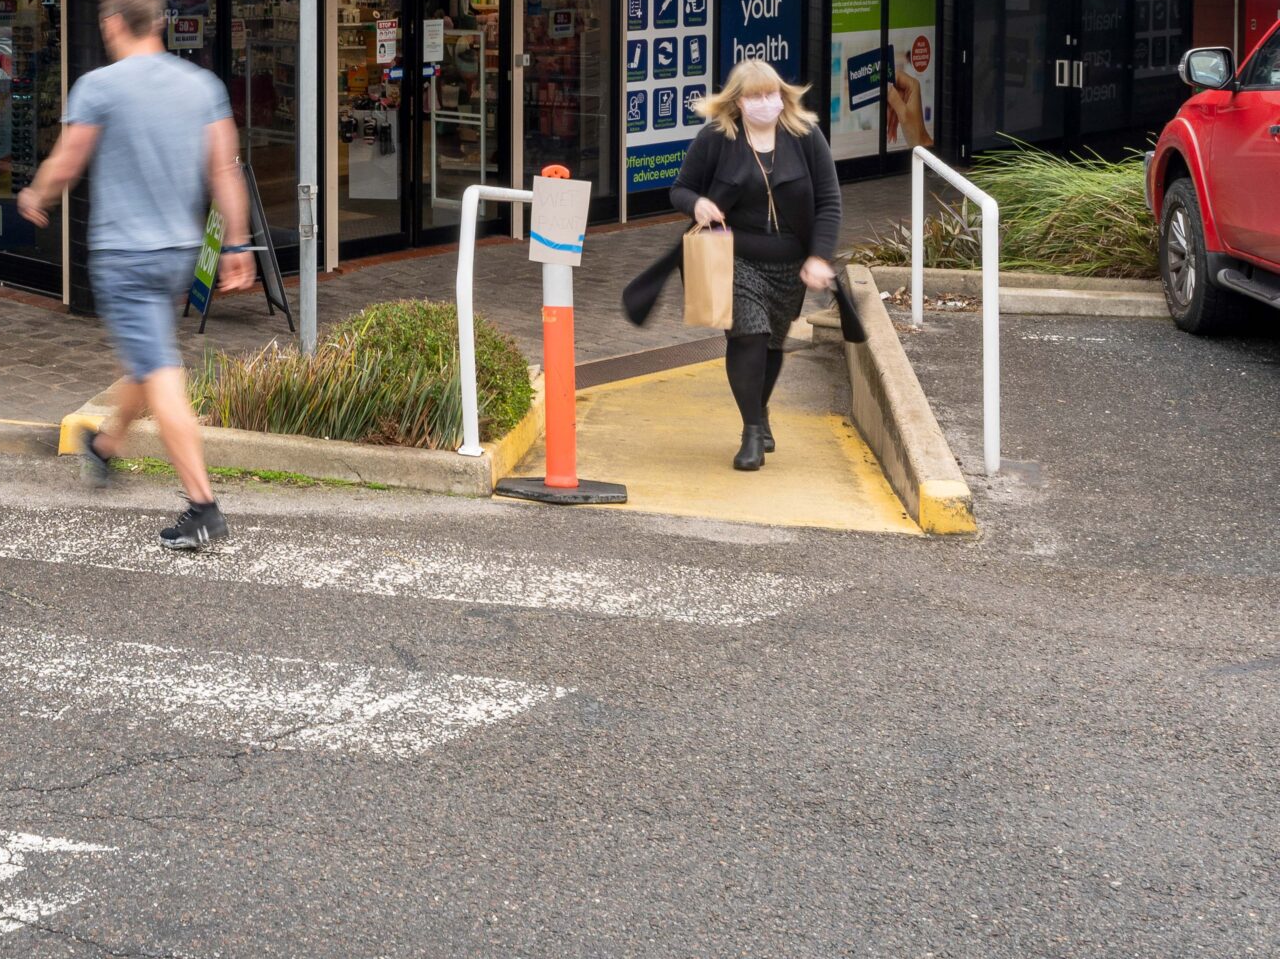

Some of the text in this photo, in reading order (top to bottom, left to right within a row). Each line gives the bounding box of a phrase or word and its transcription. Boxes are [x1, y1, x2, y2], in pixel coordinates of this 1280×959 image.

[734, 34, 789, 64] health
[656, 151, 680, 165] expert
[633, 168, 659, 183] advice
[198, 243, 218, 276] NOW
